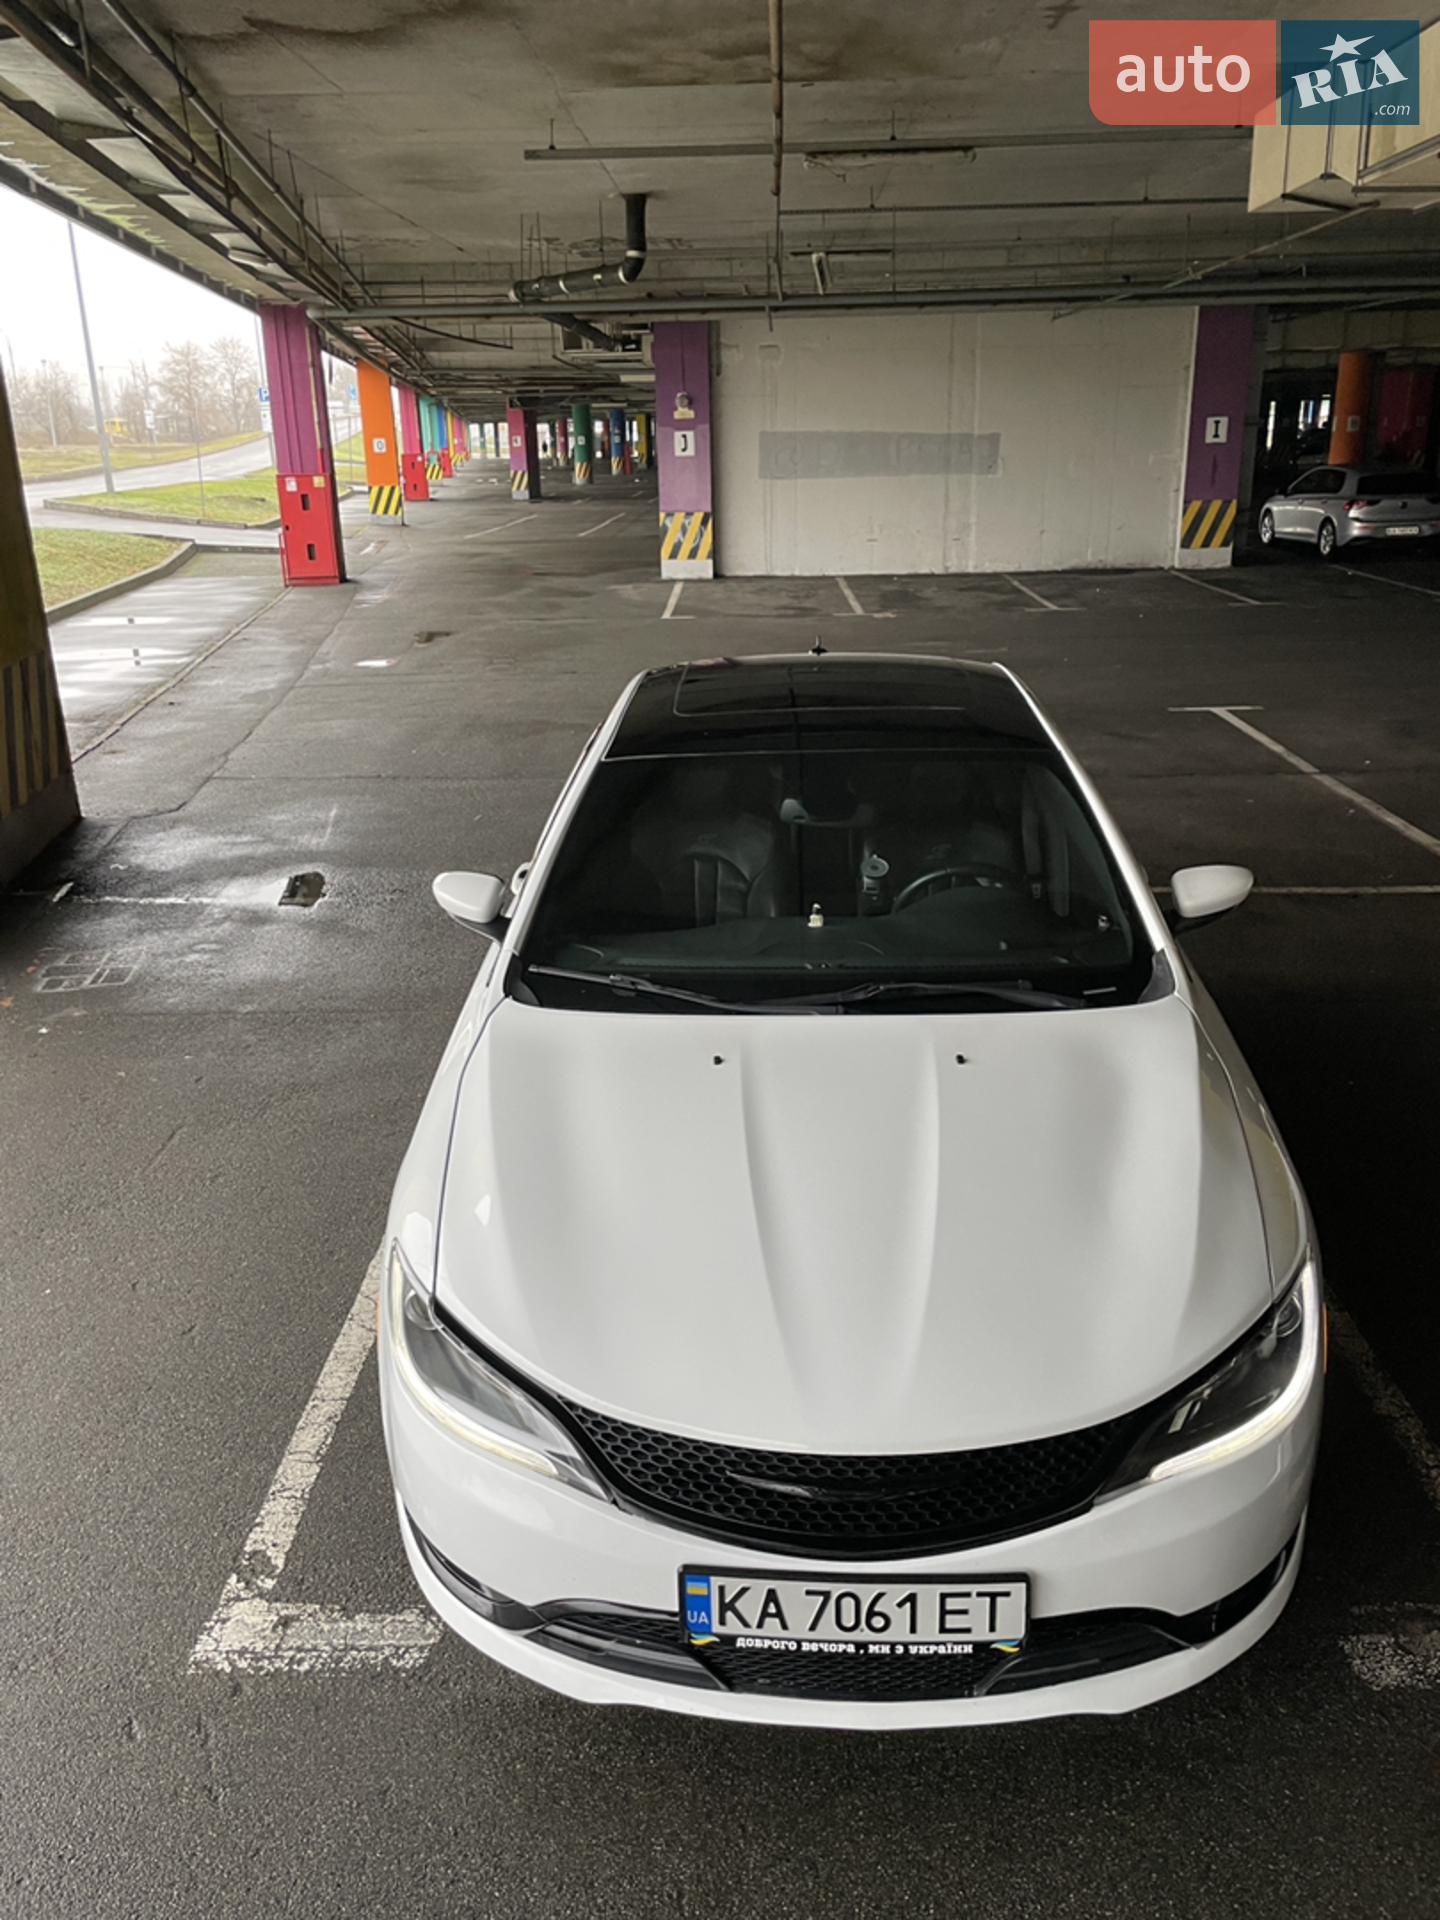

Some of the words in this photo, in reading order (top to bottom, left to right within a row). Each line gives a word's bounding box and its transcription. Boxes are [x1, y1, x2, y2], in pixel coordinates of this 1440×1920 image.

[1212, 420, 1221, 438] I
[681, 434, 688, 452] J
[687, 1610, 709, 1625] UA
[717, 1584, 789, 1631] KA
[805, 1589, 917, 1634] 7061
[938, 1591, 1011, 1634] ET
